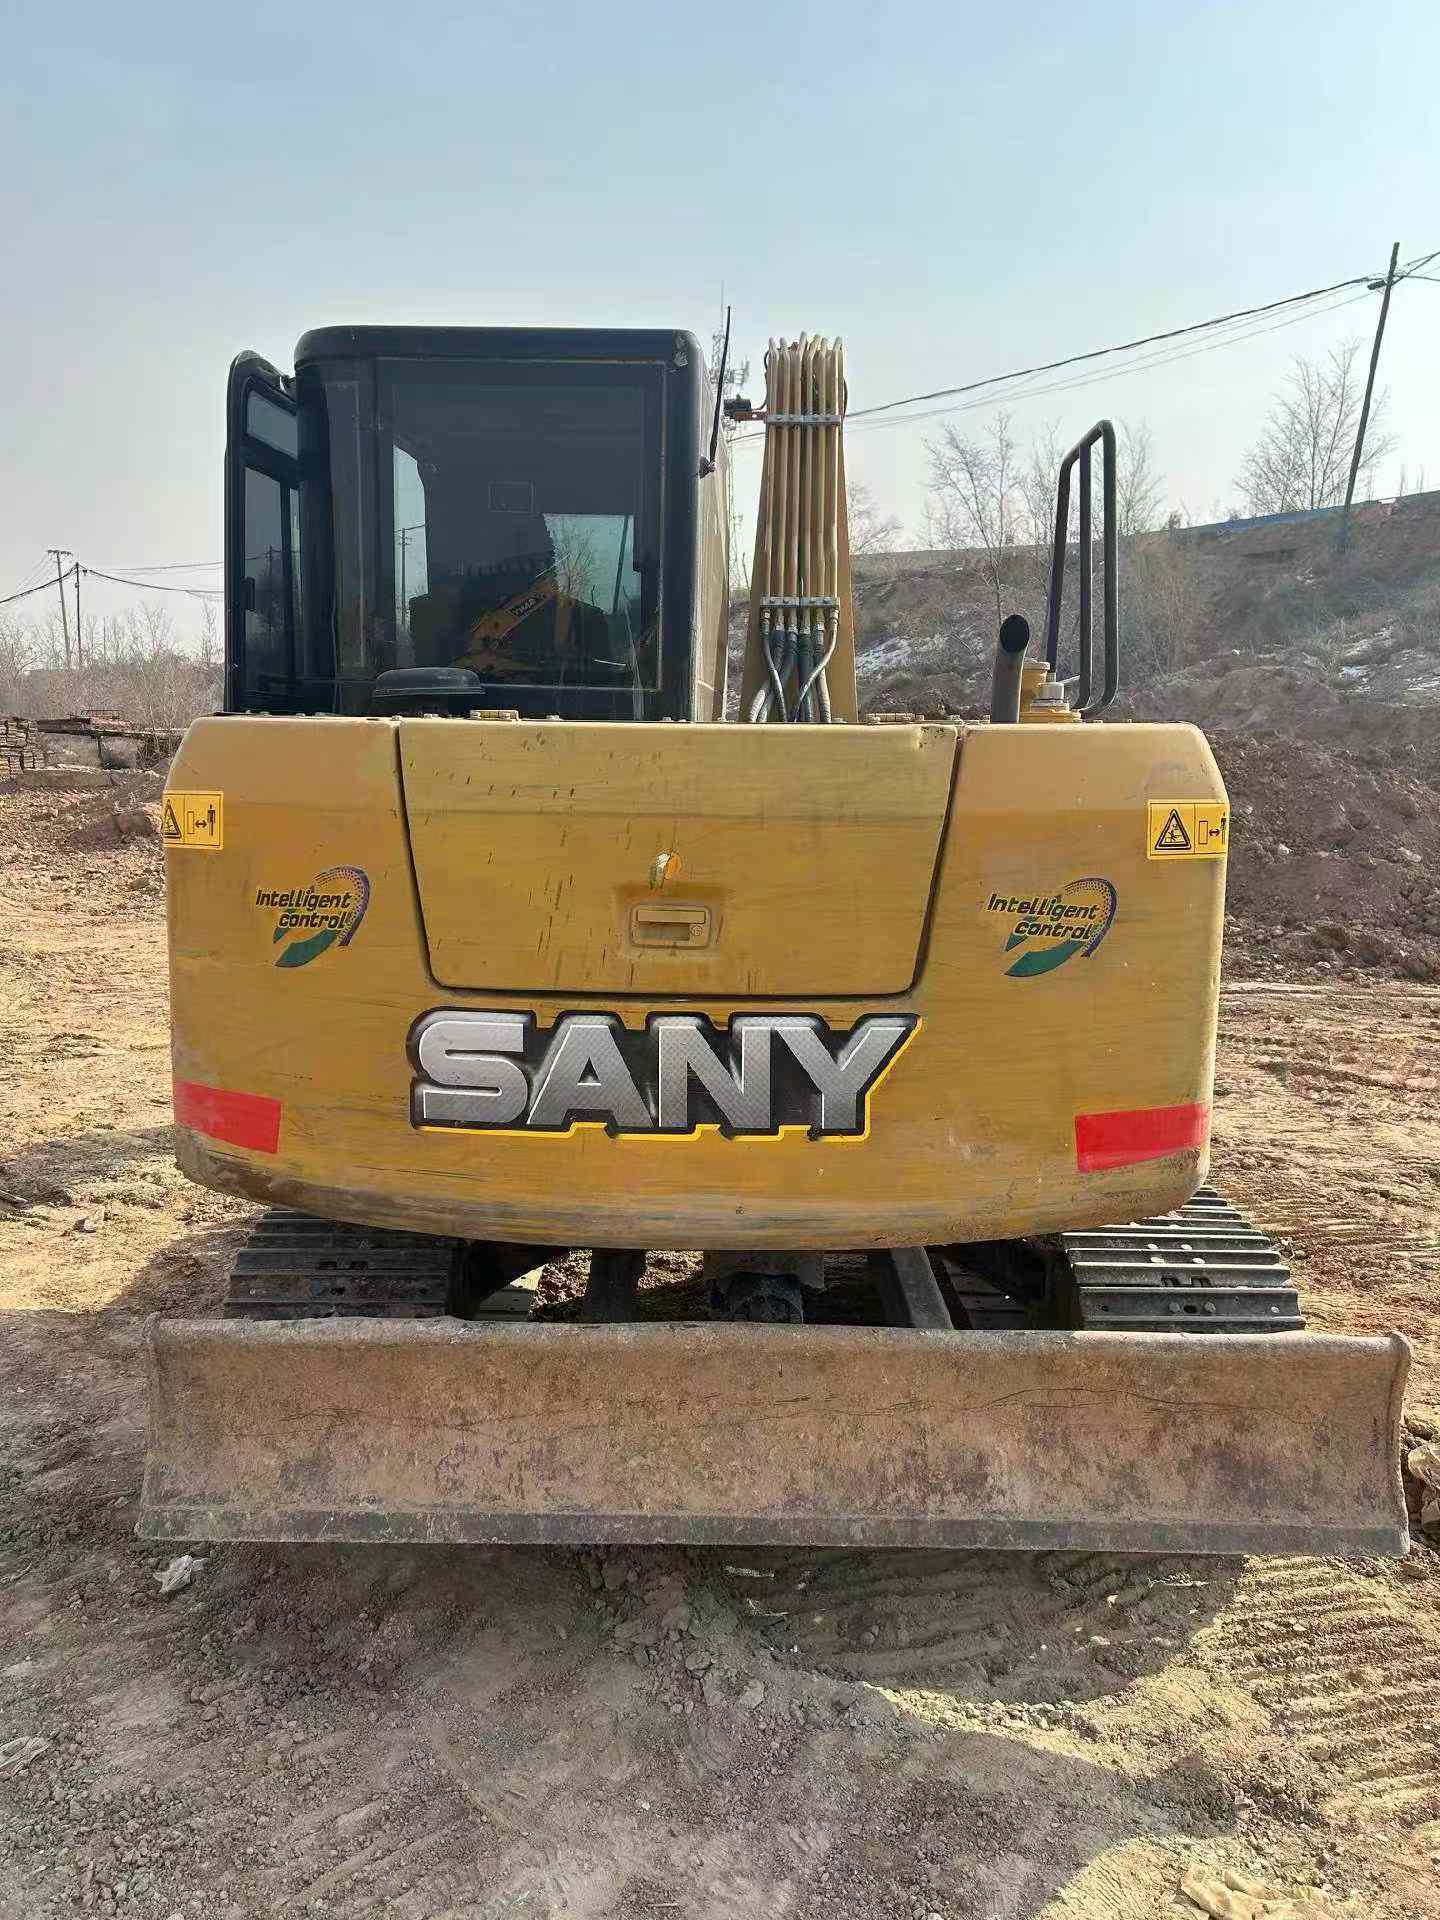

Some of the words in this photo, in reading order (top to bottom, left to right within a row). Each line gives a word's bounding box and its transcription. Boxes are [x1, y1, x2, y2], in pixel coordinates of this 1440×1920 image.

[987, 893, 1099, 921] Intelligent
[279, 911, 347, 929] control
[1013, 920, 1093, 940] control
[417, 1020, 909, 1130] SANY
